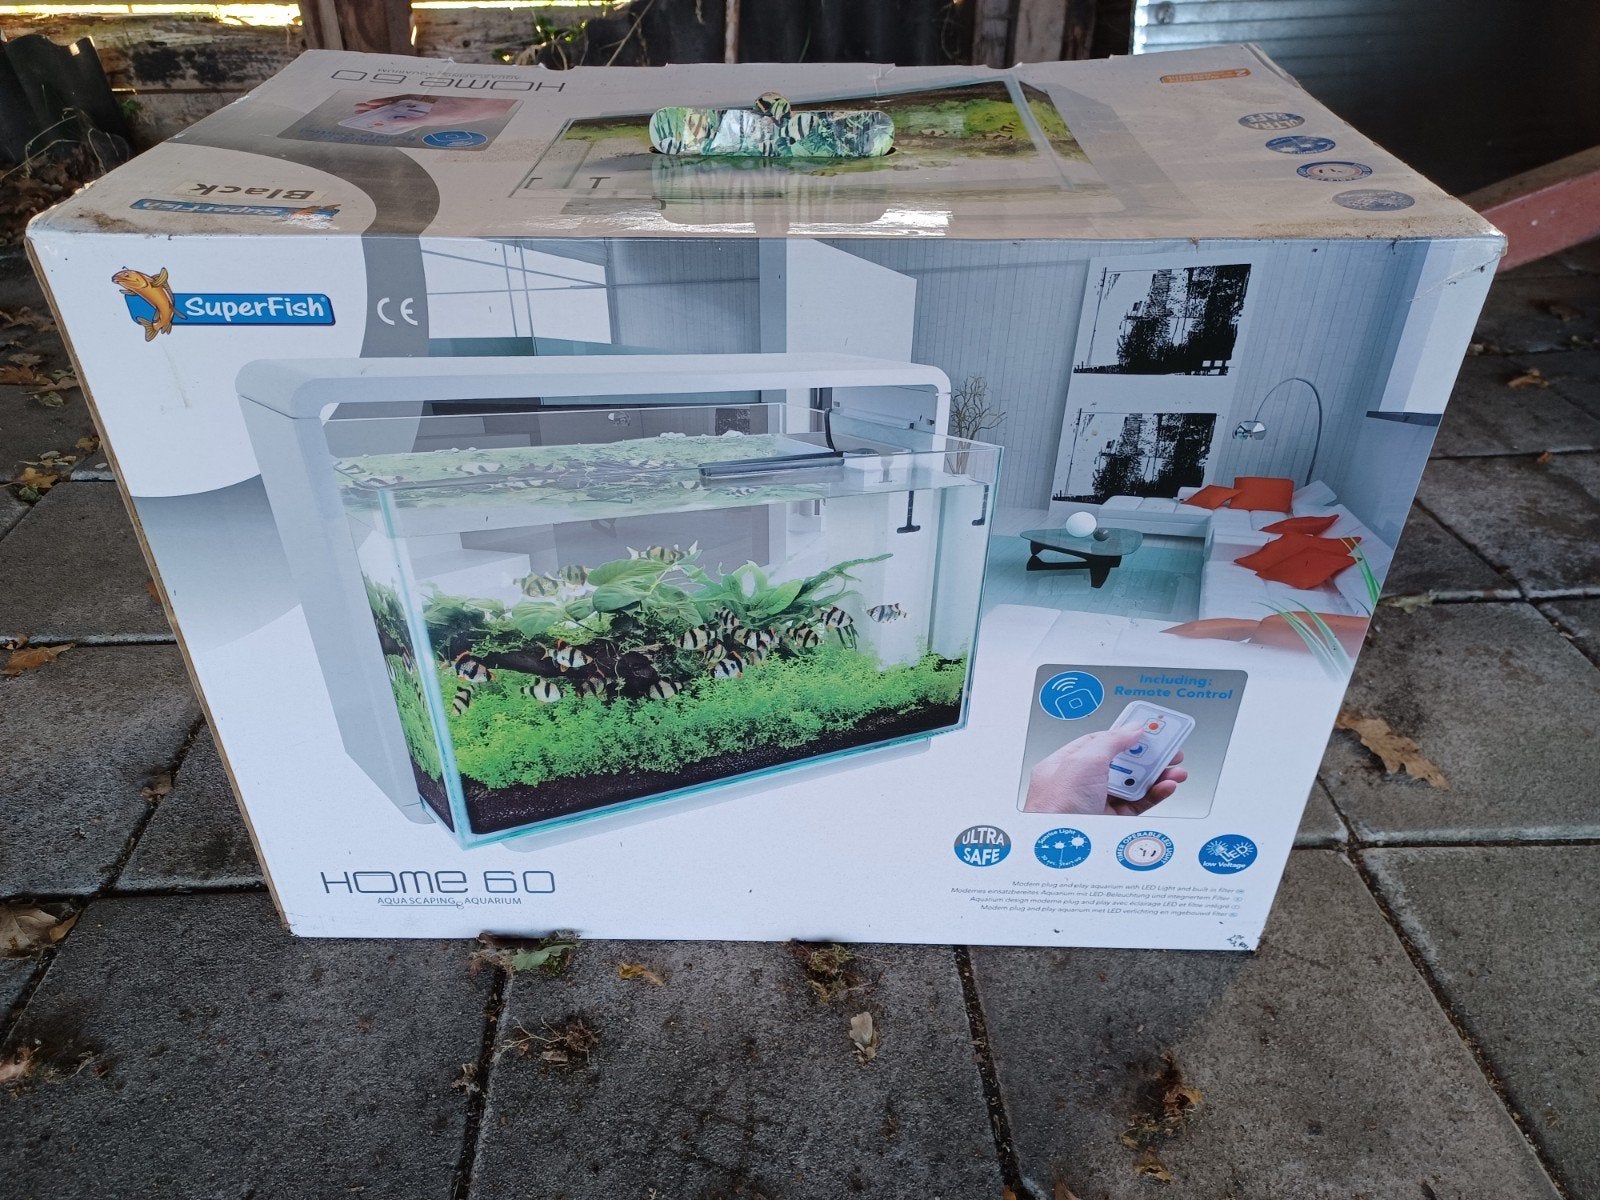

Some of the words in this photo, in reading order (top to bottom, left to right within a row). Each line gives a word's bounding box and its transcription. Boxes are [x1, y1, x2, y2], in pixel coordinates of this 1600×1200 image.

[331, 70, 407, 84] 60
[190, 184, 315, 200] Black
[185, 296, 325, 322] SuperFish
[1139, 674, 1213, 688] Including:
[1114, 686, 1172, 698] Remote
[1176, 687, 1234, 700] Control
[962, 827, 1005, 846] ULTRA
[1123, 832, 1162, 844] OPERABLE
[963, 847, 1000, 866] SAFE
[1219, 846, 1248, 862] LED
[1218, 862, 1246, 870] Voltage
[483, 870, 556, 894] 60
[464, 896, 522, 906] AQUARIUM
